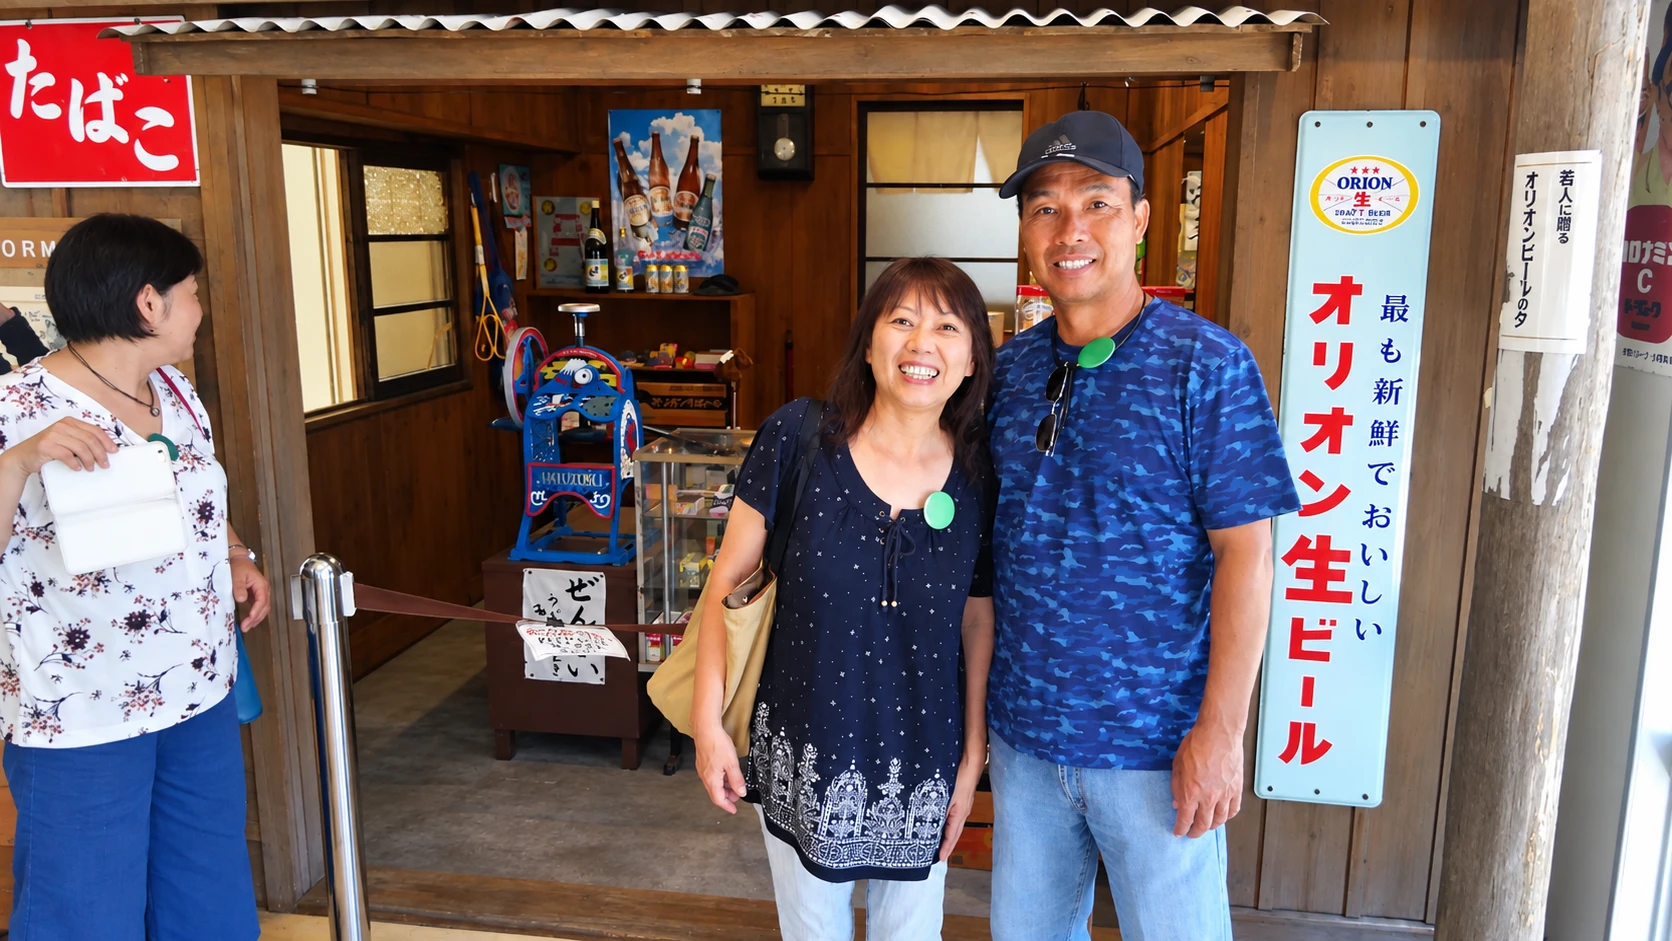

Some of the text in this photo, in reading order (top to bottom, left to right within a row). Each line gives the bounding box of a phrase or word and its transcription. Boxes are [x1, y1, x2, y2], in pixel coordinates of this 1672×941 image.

[5, 38, 180, 171] たばこ
[1337, 176, 1393, 190] ORION
[1353, 191, 1371, 207] 生
[1556, 169, 1575, 244] 若人に贈る
[1637, 268, 1653, 293] C
[1355, 294, 1410, 641] 最も新鮮でおいしい
[1278, 275, 1363, 765] オリオン生ビール
